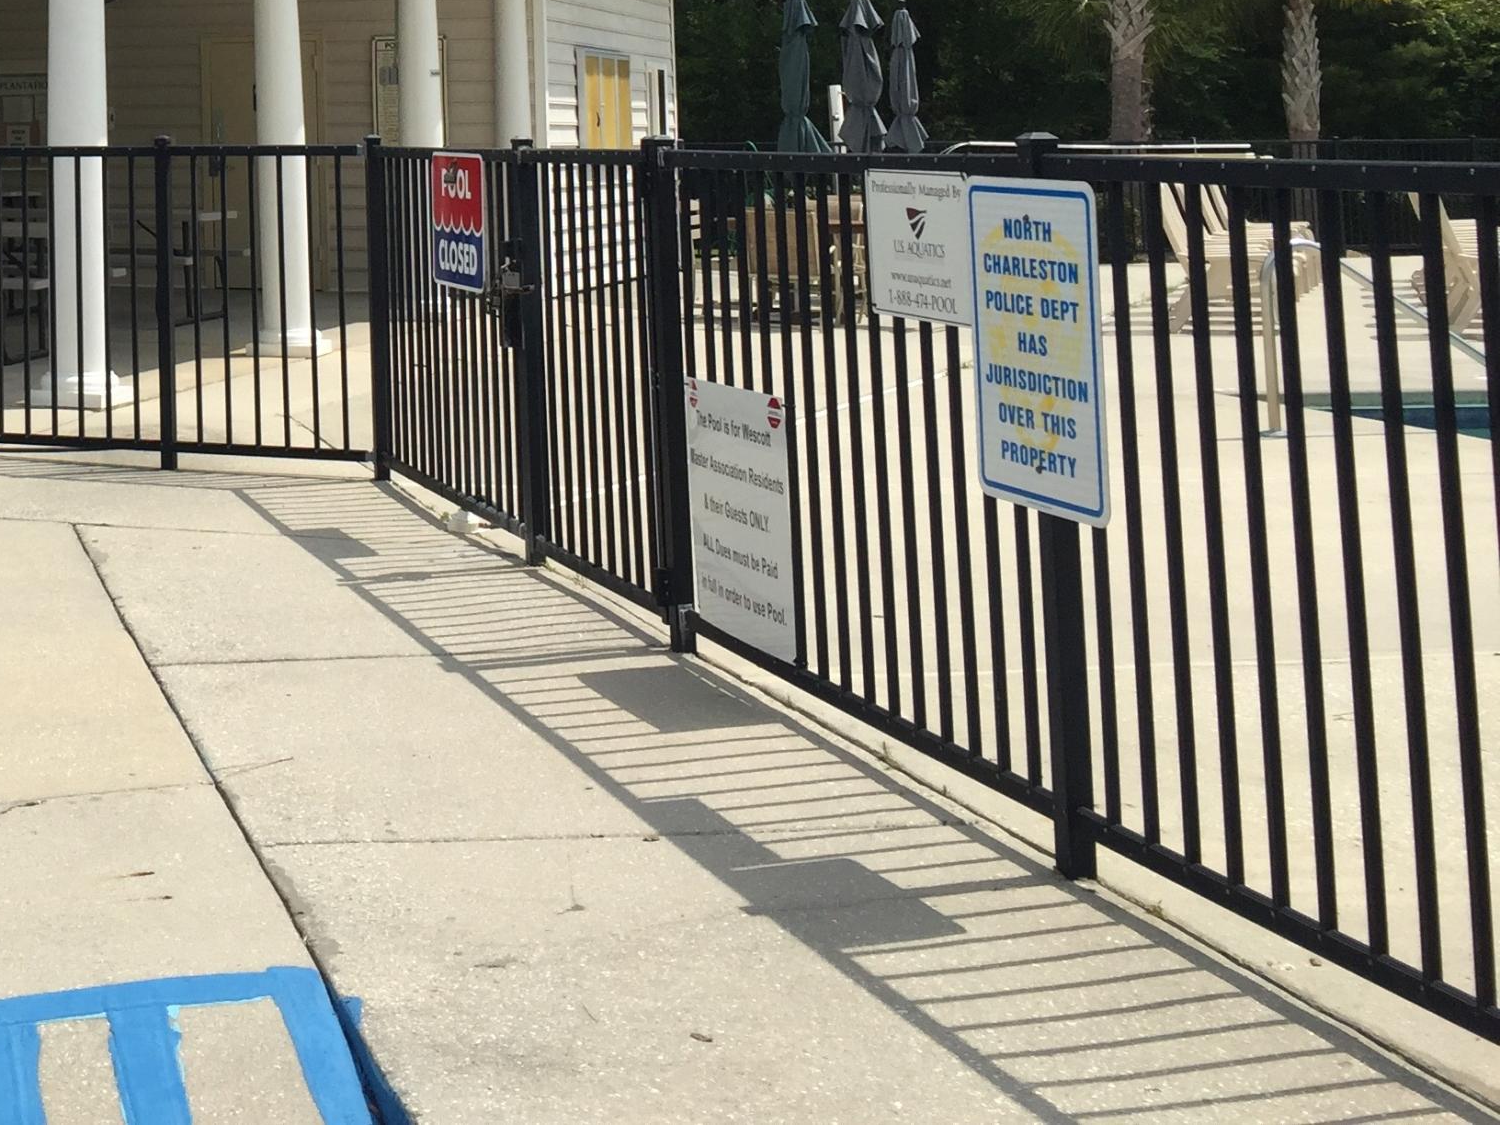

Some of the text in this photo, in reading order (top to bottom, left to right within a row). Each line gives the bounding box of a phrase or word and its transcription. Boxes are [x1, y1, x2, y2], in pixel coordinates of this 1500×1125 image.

[871, 180, 962, 202] Professionally Managed By
[1003, 217, 1052, 243] NORTH
[438, 238, 478, 276] CLOSED
[907, 241, 946, 259] AQUATICS
[983, 252, 1079, 285] CHARLESTON
[985, 289, 1080, 324] POLICE DEPT
[1017, 331, 1048, 357] HAS
[985, 362, 1089, 404] JURISDICTION
[696, 409, 771, 448] The Pool is for Wescott
[998, 401, 1077, 440] OVER THIS
[710, 455, 747, 483] Association
[748, 467, 784, 495] Residents
[1001, 439, 1077, 479] PROPERTY
[709, 495, 724, 516] their
[725, 501, 748, 526] Guests
[703, 533, 779, 580] ALL Dues must be Paid
[701, 572, 788, 627] in full in order to use Pool.
